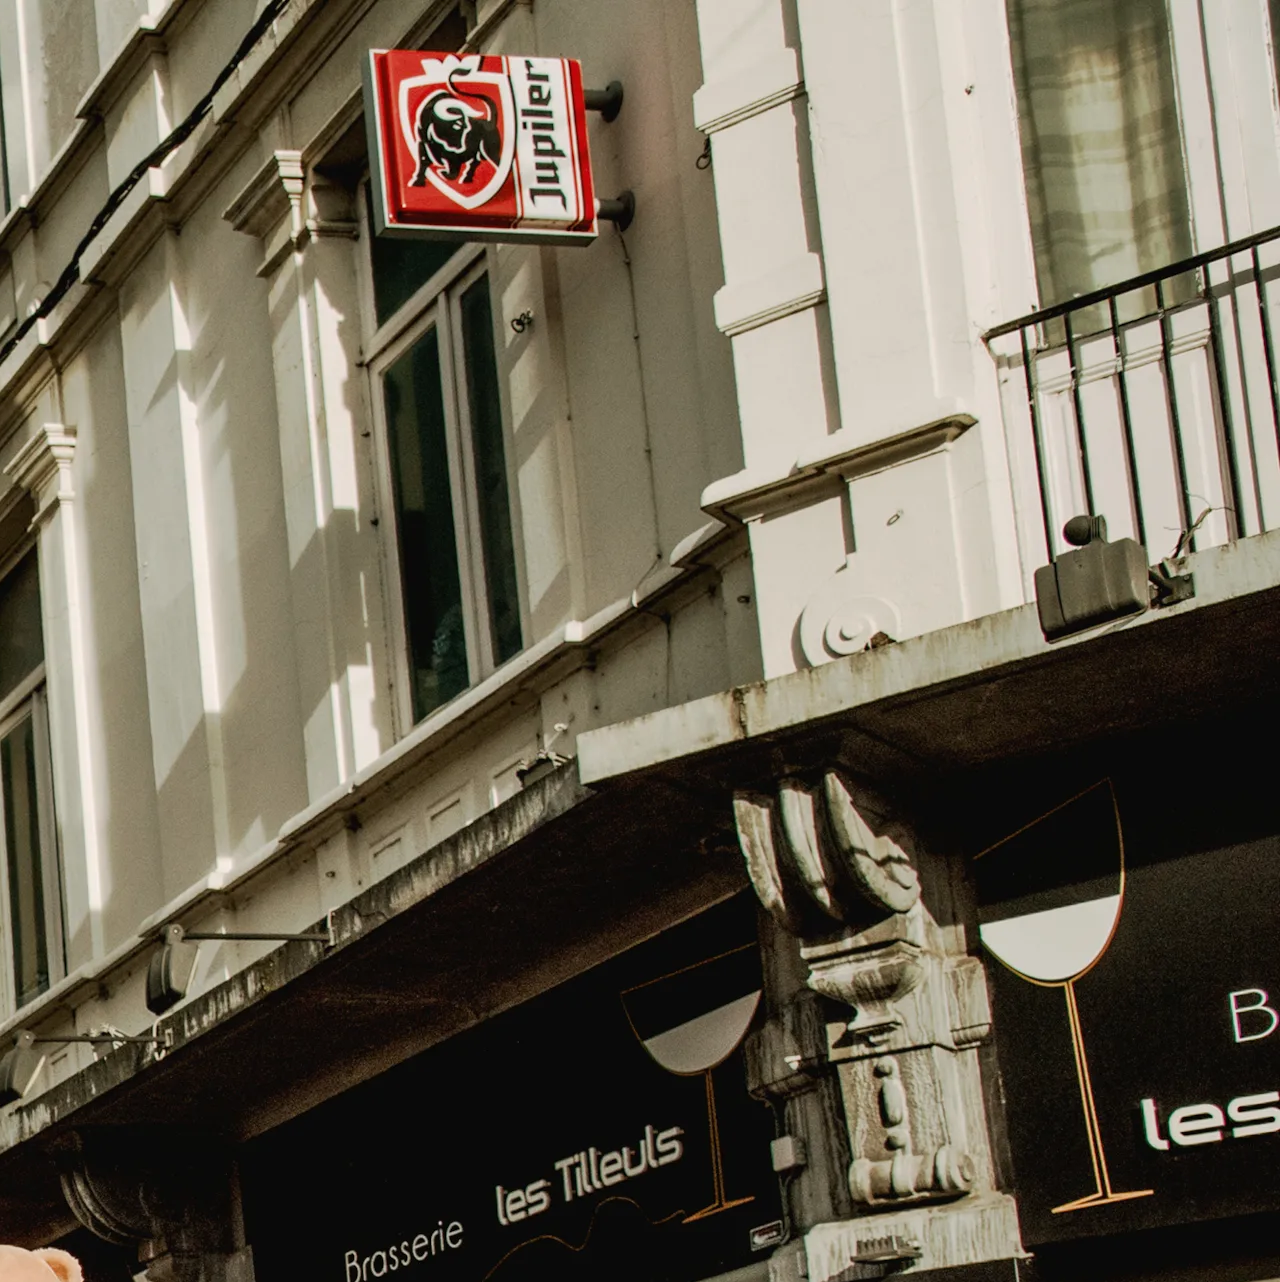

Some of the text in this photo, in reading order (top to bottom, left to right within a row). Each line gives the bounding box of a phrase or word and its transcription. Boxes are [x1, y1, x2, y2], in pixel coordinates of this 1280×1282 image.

[522, 59, 568, 212] Jupiler
[1141, 1091, 1280, 1150] les
[495, 1179, 551, 1226] les
[554, 1124, 685, 1202] Tilleuls
